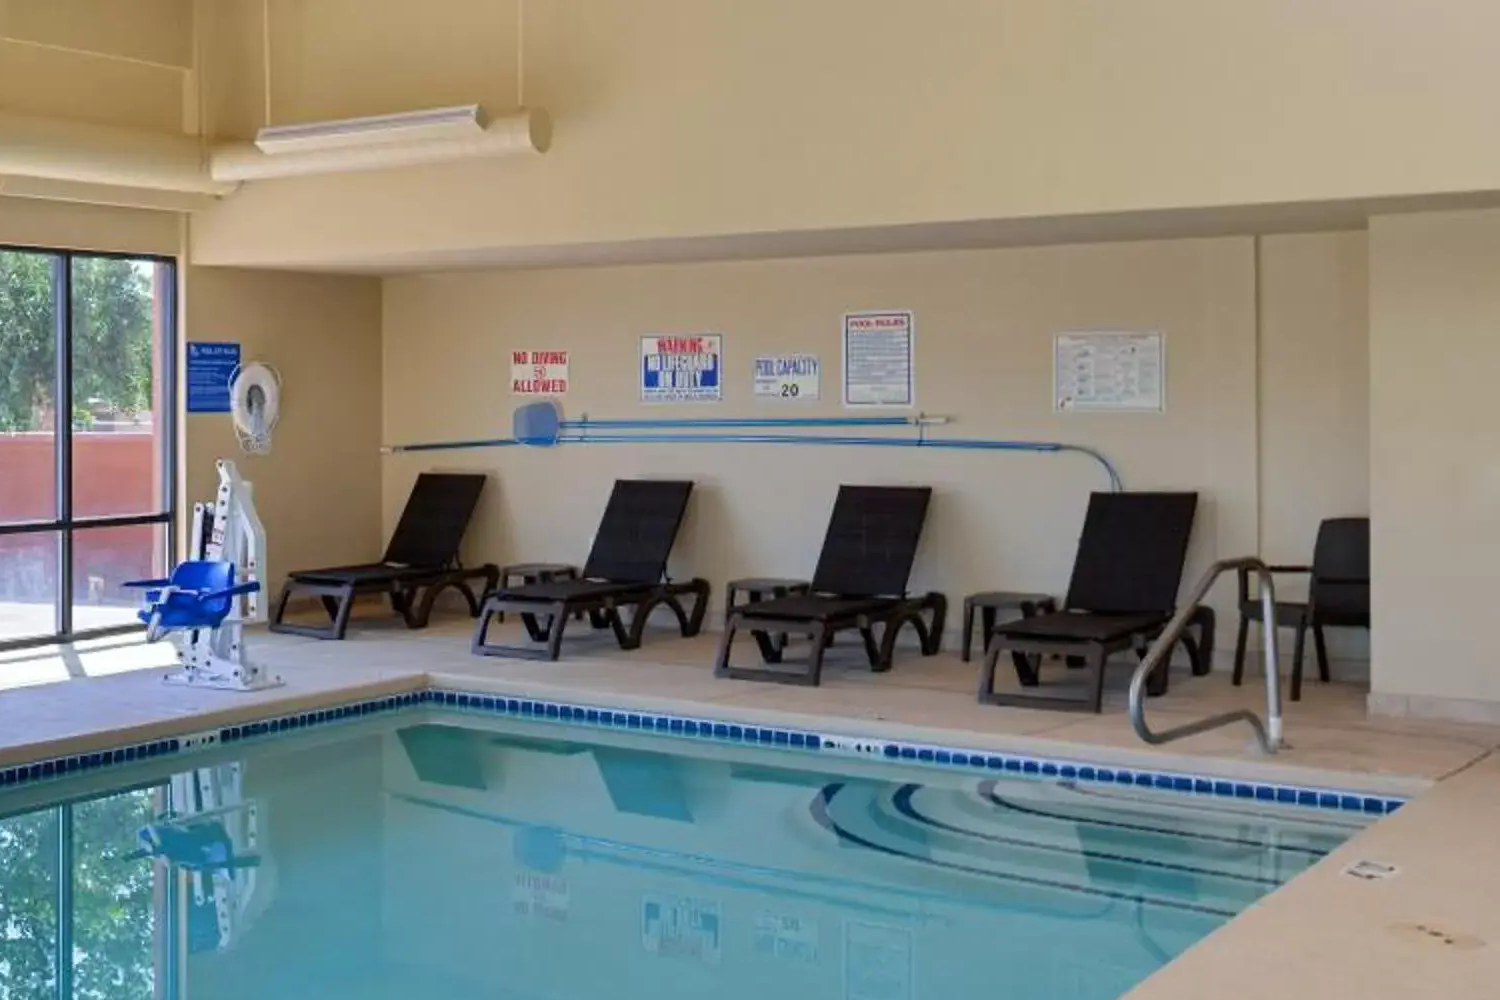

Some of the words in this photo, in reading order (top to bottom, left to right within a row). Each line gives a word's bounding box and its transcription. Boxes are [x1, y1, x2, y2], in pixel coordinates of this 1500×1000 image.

[513, 351, 528, 365] NO
[531, 351, 567, 365] DIVING
[776, 358, 818, 377] CAPACITY
[513, 379, 567, 393] ALLOWED
[781, 383, 799, 398] 20
